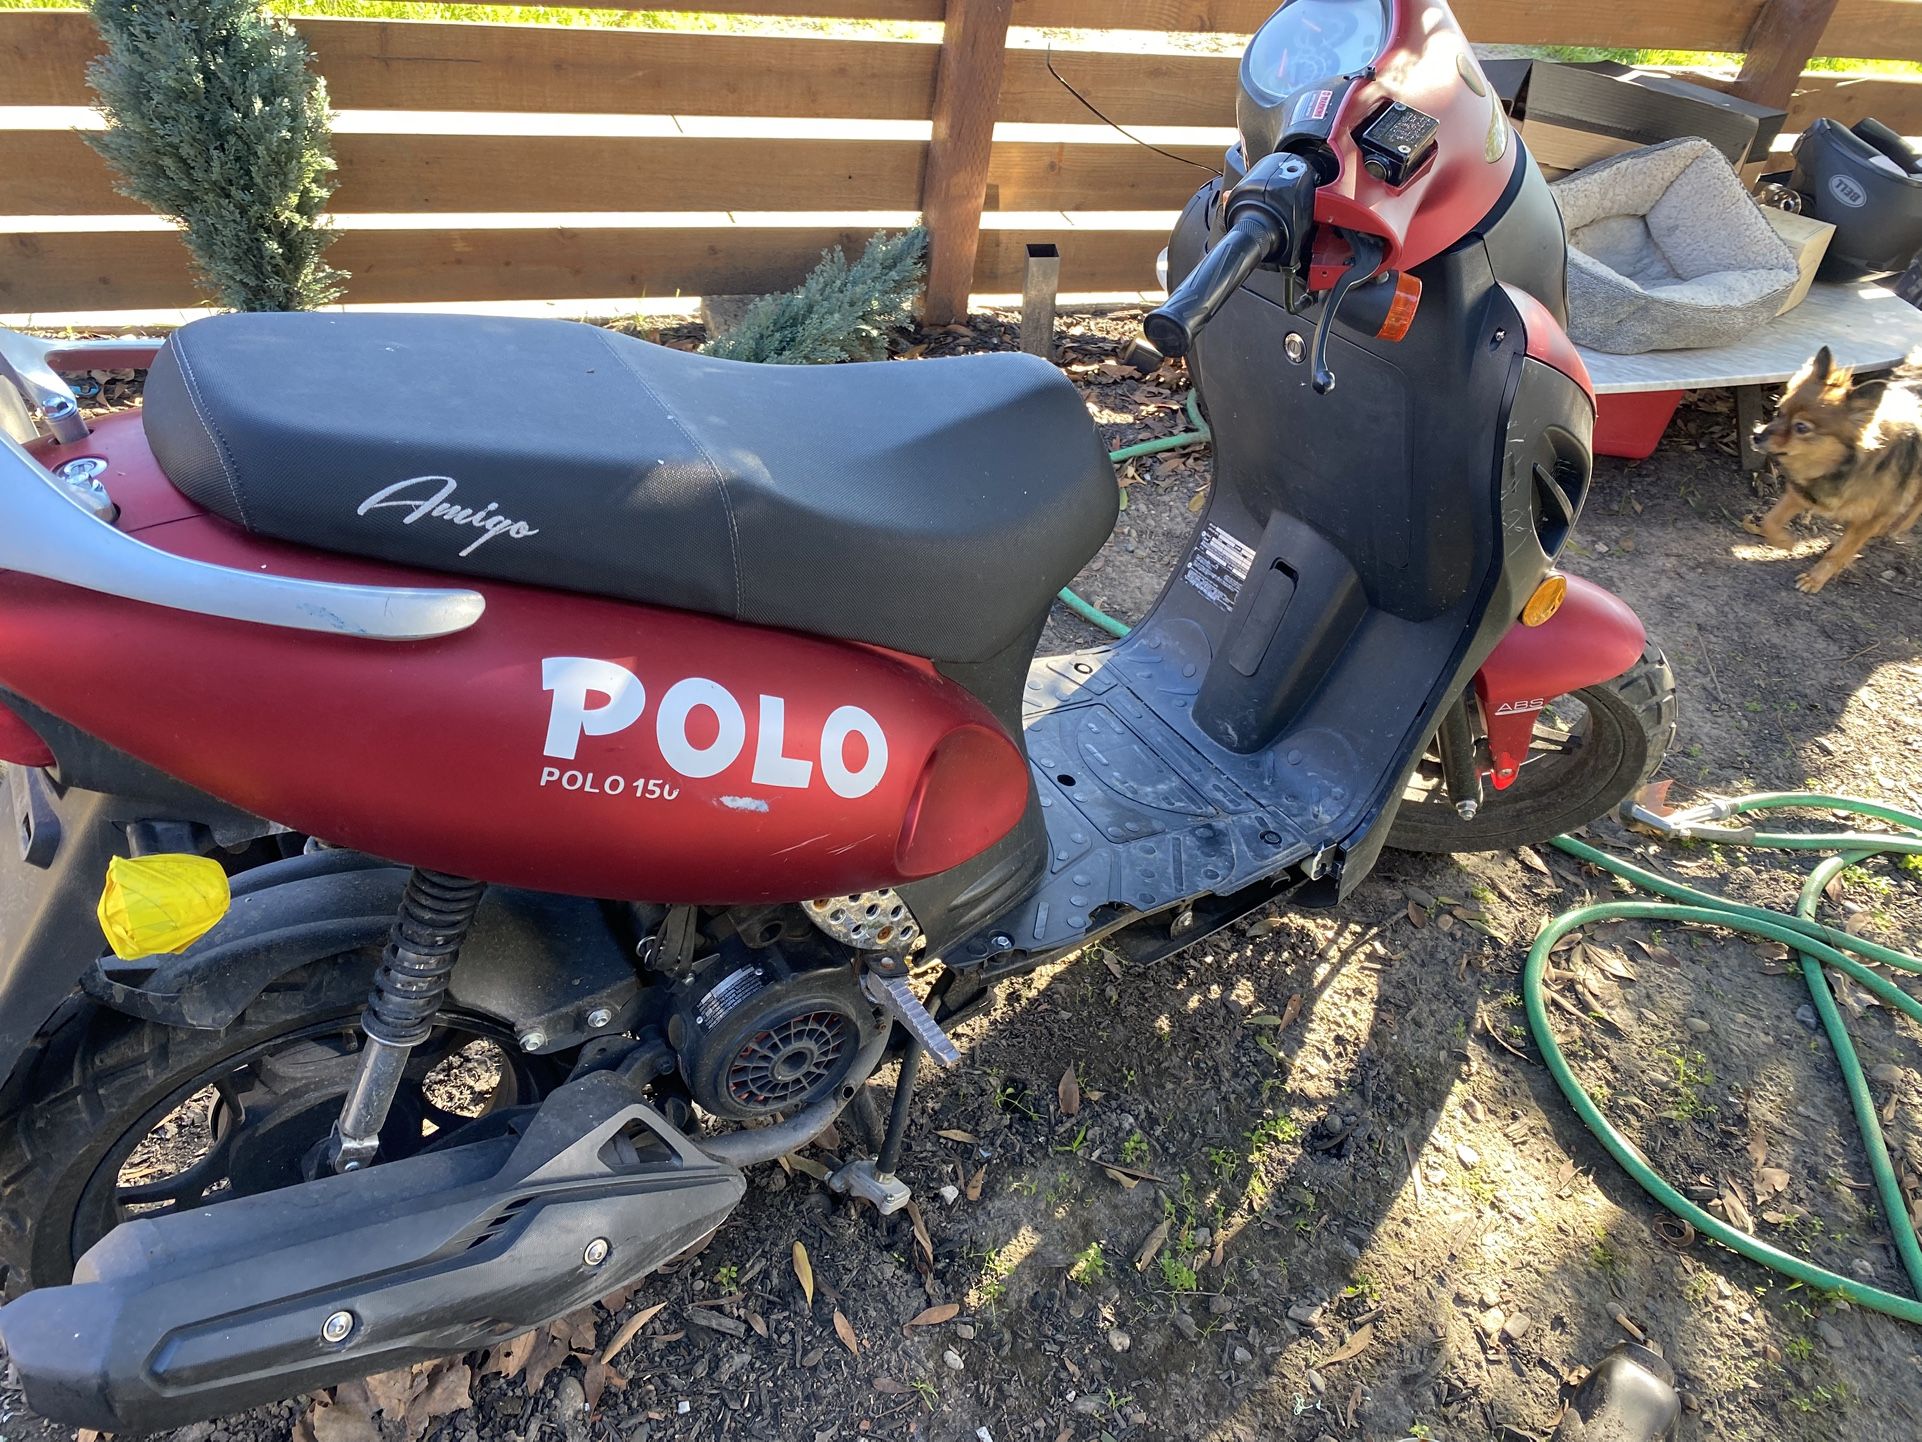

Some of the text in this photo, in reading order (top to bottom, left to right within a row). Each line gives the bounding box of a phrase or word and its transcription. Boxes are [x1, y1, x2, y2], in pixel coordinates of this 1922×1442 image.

[1835, 178, 1861, 202] BELL
[357, 475, 540, 557] Amigo
[1497, 698, 1545, 712] ABS
[542, 656, 889, 799] POLO
[540, 767, 625, 795] POLO
